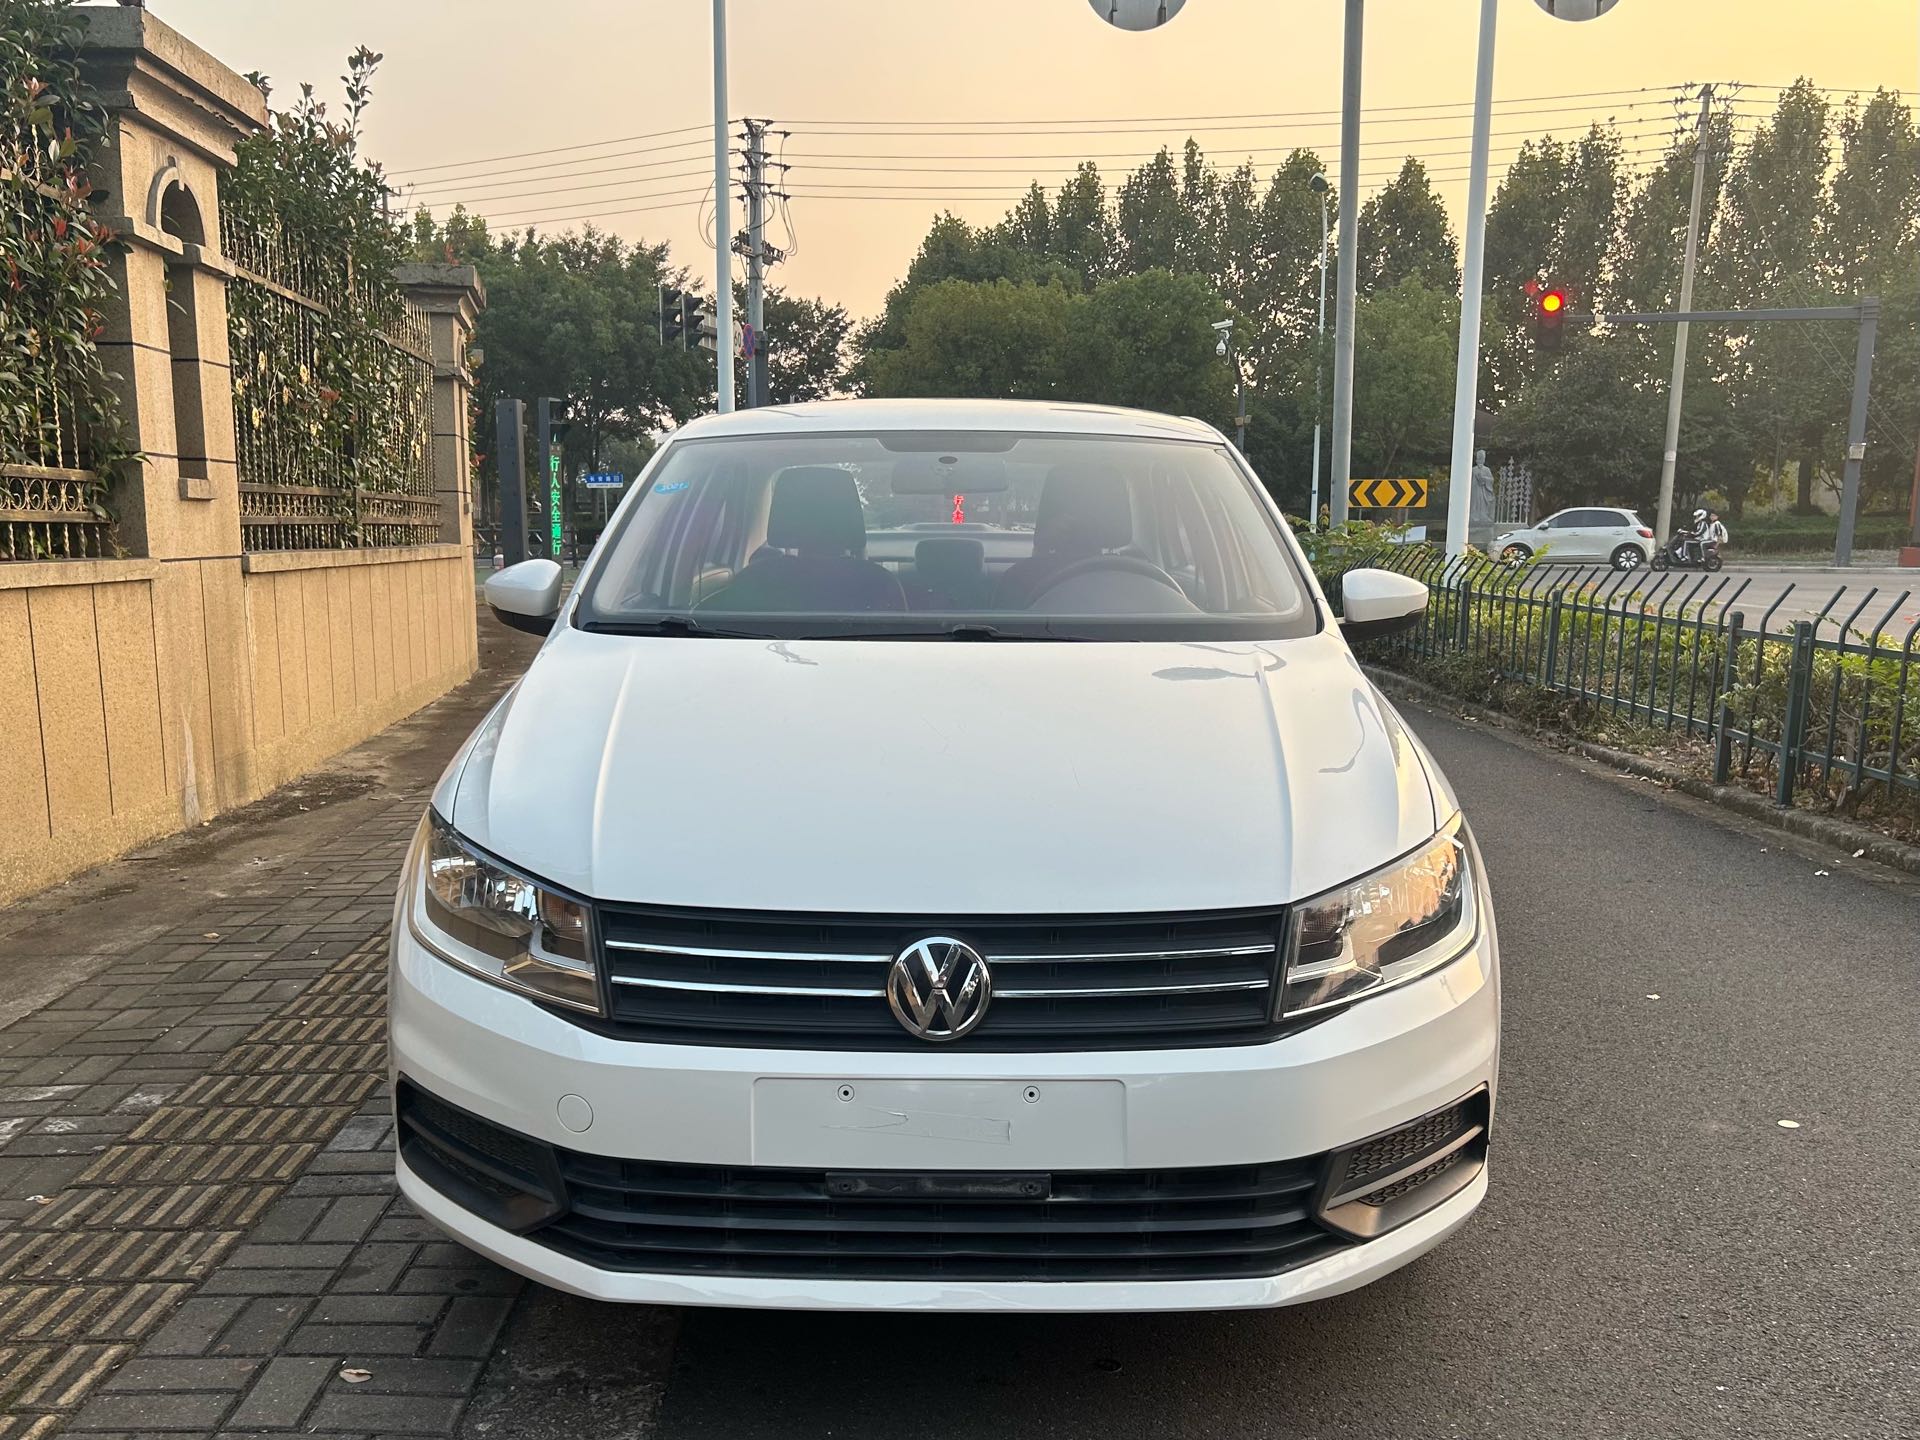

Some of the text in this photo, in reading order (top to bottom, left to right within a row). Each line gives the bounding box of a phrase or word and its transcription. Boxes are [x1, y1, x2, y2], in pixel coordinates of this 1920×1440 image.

[550, 455, 561, 555] 行人安全通行
[888, 937, 991, 1041] VW
